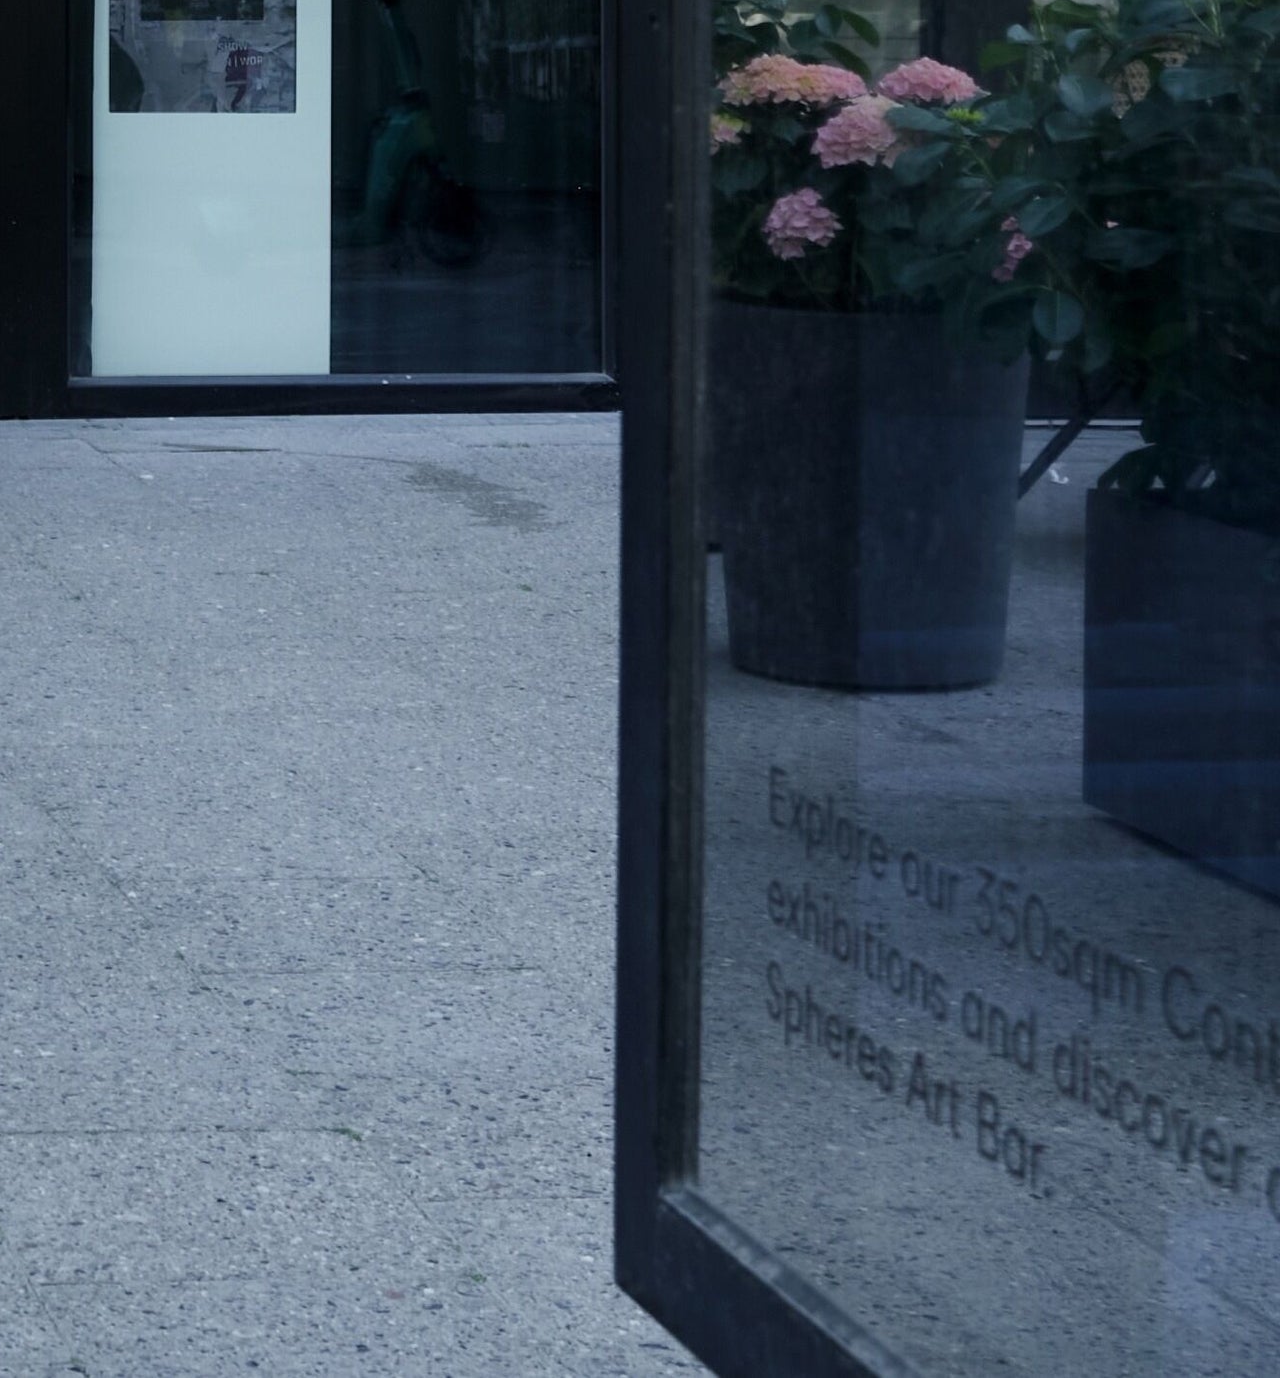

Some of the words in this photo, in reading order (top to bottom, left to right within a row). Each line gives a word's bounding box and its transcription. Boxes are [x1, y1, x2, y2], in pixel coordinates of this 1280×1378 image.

[768, 765, 892, 881] Explore
[898, 846, 962, 911] our
[976, 865, 1146, 1016] 350sqm
[765, 960, 895, 1095] Spheres
[905, 1051, 963, 1141] Art
[766, 874, 948, 1024] exhibitions
[960, 987, 1038, 1076] and
[1052, 1032, 1249, 1195] discover
